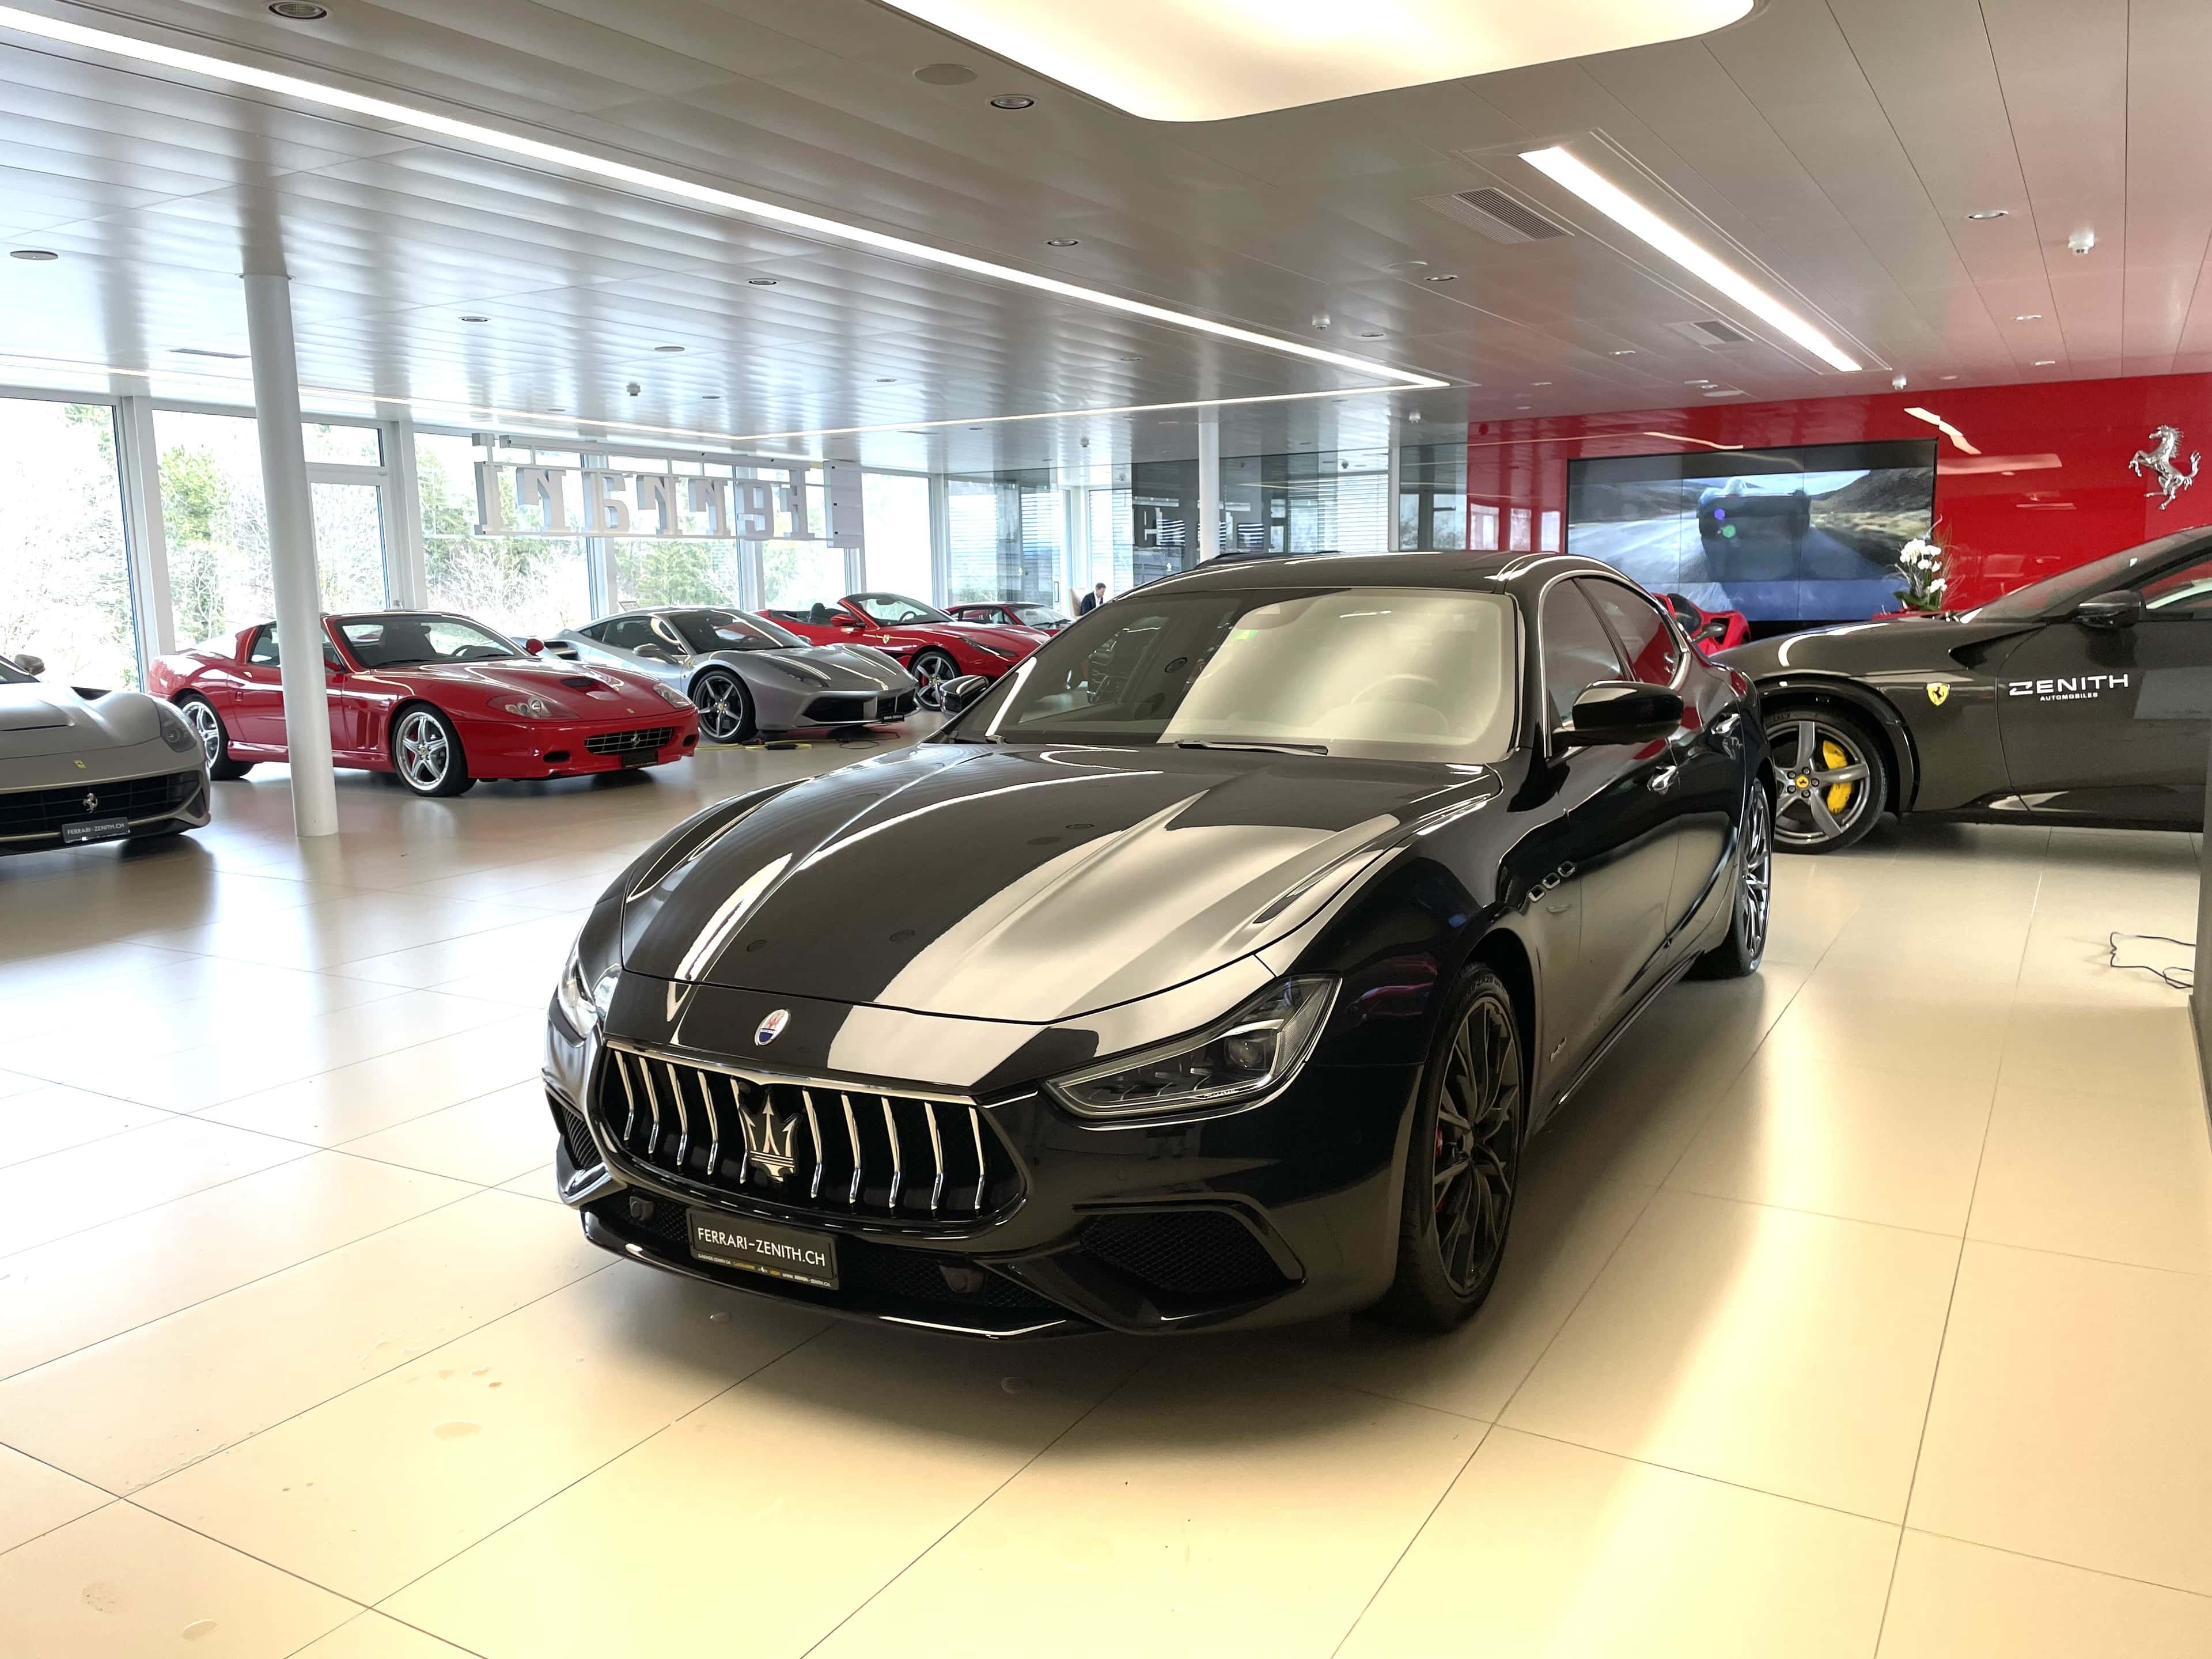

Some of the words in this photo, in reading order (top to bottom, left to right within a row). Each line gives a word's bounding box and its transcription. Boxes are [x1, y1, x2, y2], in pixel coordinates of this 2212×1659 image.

[2009, 673, 2129, 696] ZENITH
[2040, 692, 2099, 702] AUTOMOBILES
[697, 1227, 825, 1267] FERRARI-ZENITH.CH
